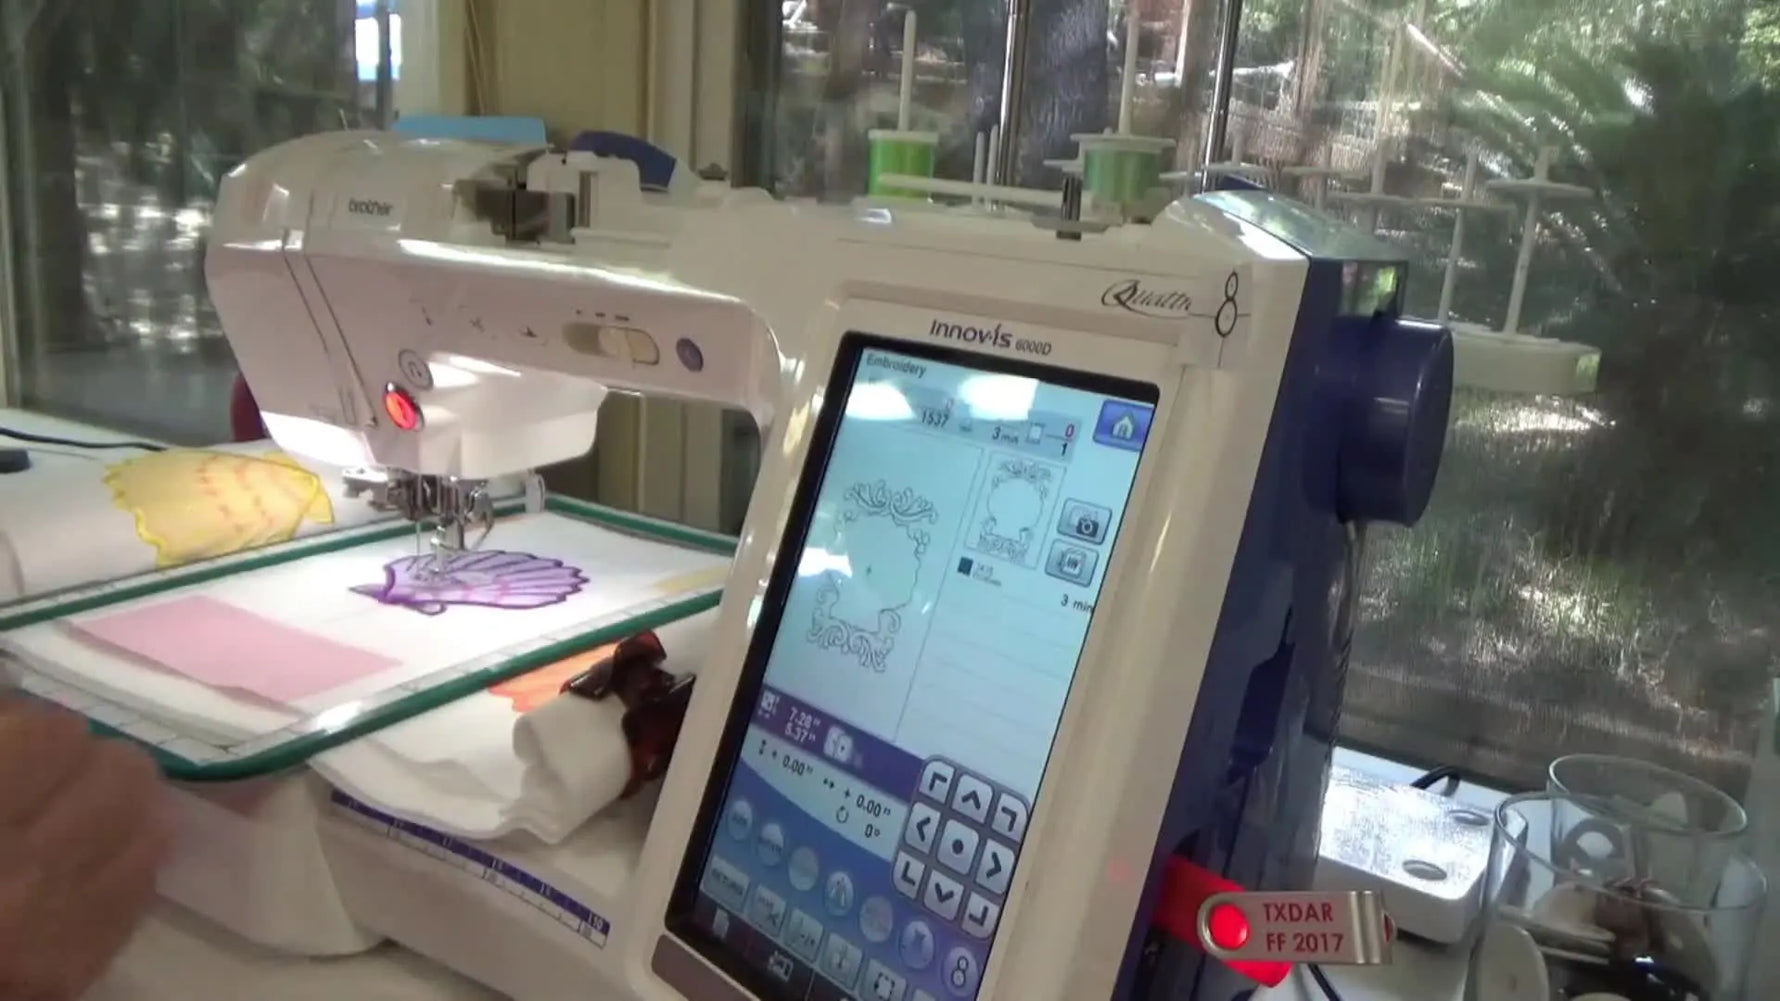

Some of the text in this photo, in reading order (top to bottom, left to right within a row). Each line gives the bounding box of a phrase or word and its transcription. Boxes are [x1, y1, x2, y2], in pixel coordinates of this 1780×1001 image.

[1015, 339, 1052, 357] 6000D
[866, 354, 927, 378] Embroidery
[921, 408, 949, 426] 1537
[992, 426, 1020, 446] 3 min
[1065, 423, 1075, 438] 0
[1060, 593, 1094, 614] 3 min
[1263, 903, 1334, 923] TXDAR
[1266, 933, 1344, 953] FF 2017
